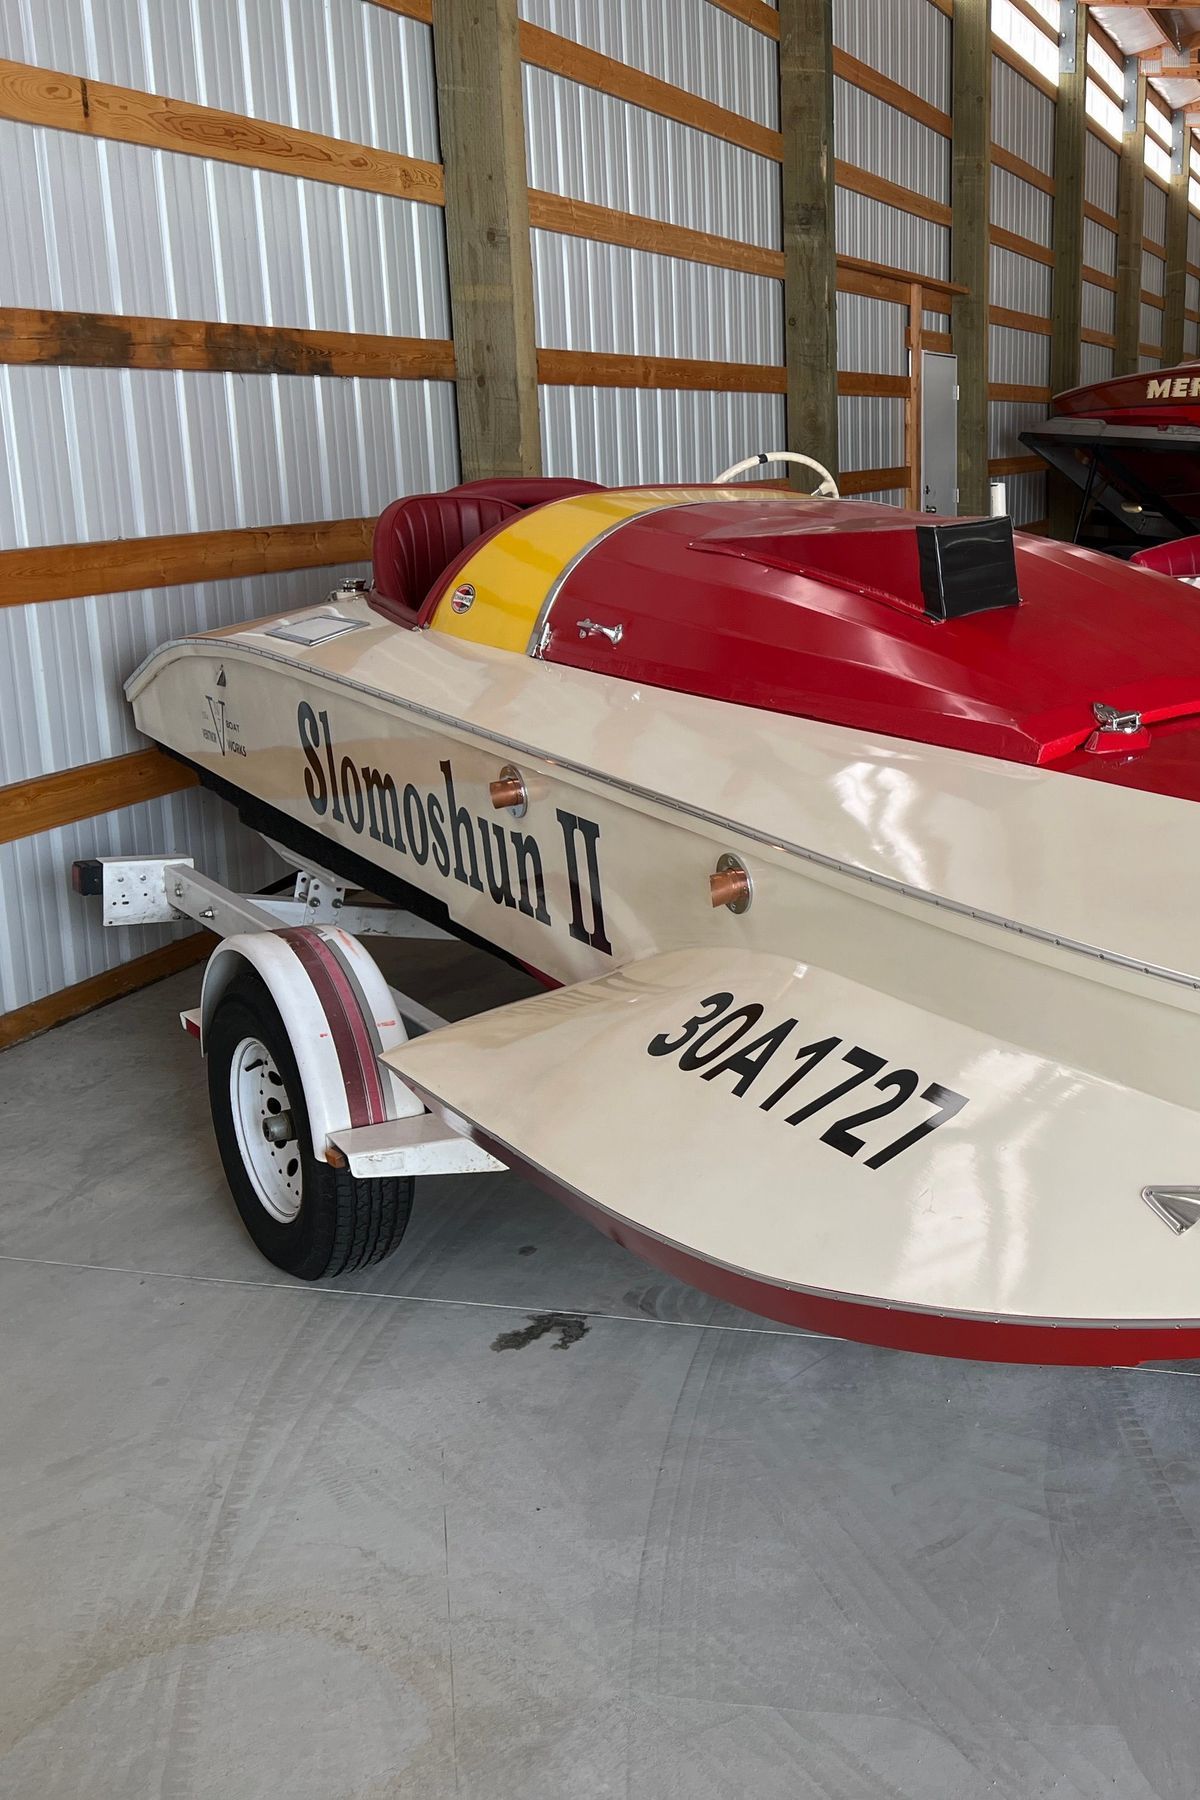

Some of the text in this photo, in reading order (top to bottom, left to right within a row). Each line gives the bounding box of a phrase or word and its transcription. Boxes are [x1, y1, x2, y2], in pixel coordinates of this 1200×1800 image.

[225, 720, 240, 732] BOAT
[227, 740, 247, 757] WORKS
[296, 701, 612, 956] Slomoshun II
[647, 992, 970, 1170] 30A1727
